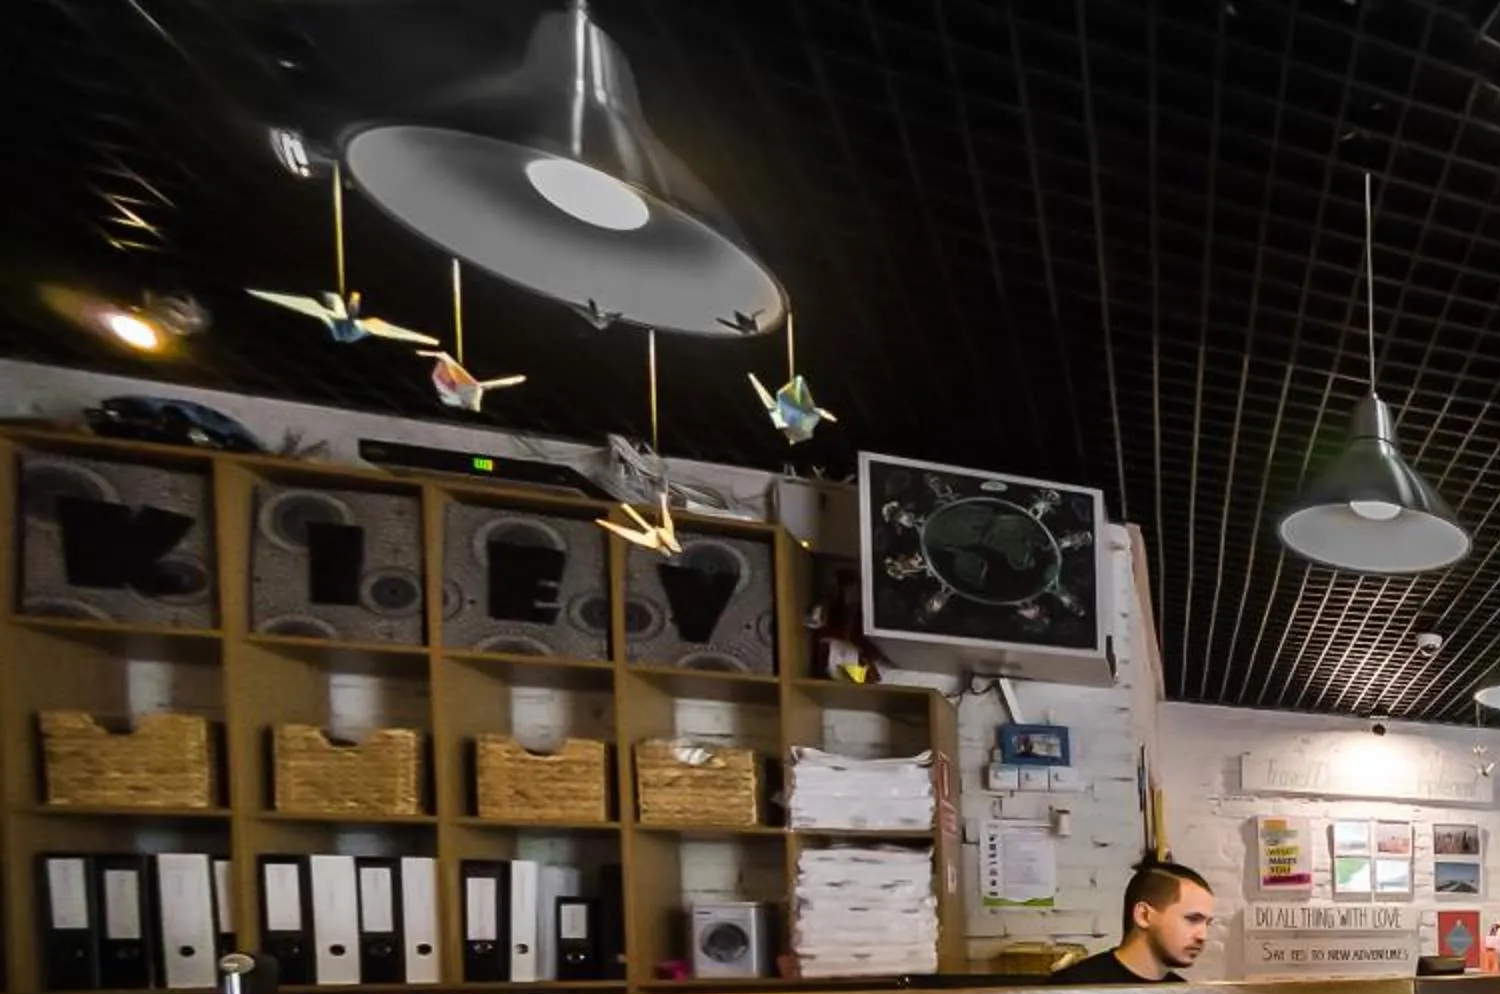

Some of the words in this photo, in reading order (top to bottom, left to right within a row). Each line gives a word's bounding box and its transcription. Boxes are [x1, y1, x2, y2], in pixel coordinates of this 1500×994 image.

[1255, 907, 1273, 928] DO
[1275, 907, 1298, 929] ALL
[1337, 907, 1368, 928] WITH
[1372, 907, 1402, 929] LOVE
